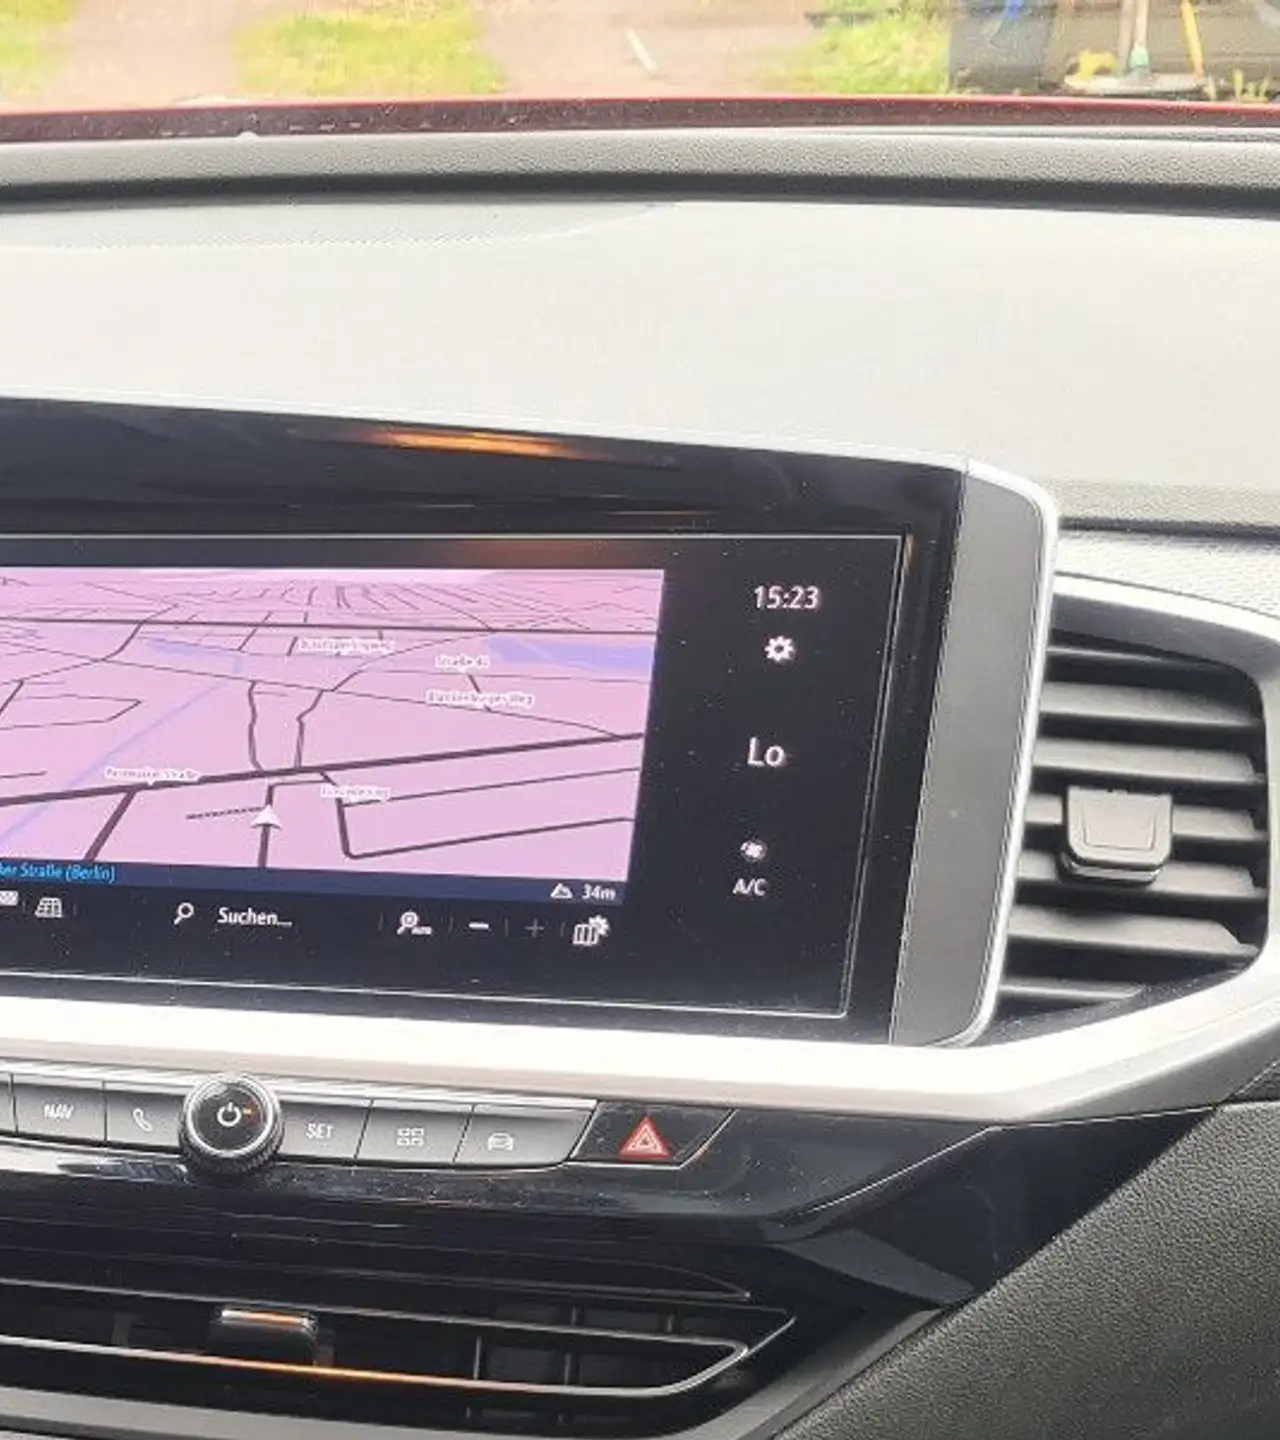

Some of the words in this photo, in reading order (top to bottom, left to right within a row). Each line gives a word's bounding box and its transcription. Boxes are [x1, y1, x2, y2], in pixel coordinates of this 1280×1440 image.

[753, 585, 820, 609] 15:23
[747, 736, 785, 767] Lo
[65, 864, 116, 883] (Berlin)
[581, 884, 616, 900] 34m
[733, 878, 767, 896] A/C
[44, 1104, 72, 1120] NAV
[304, 1122, 334, 1140] SET
